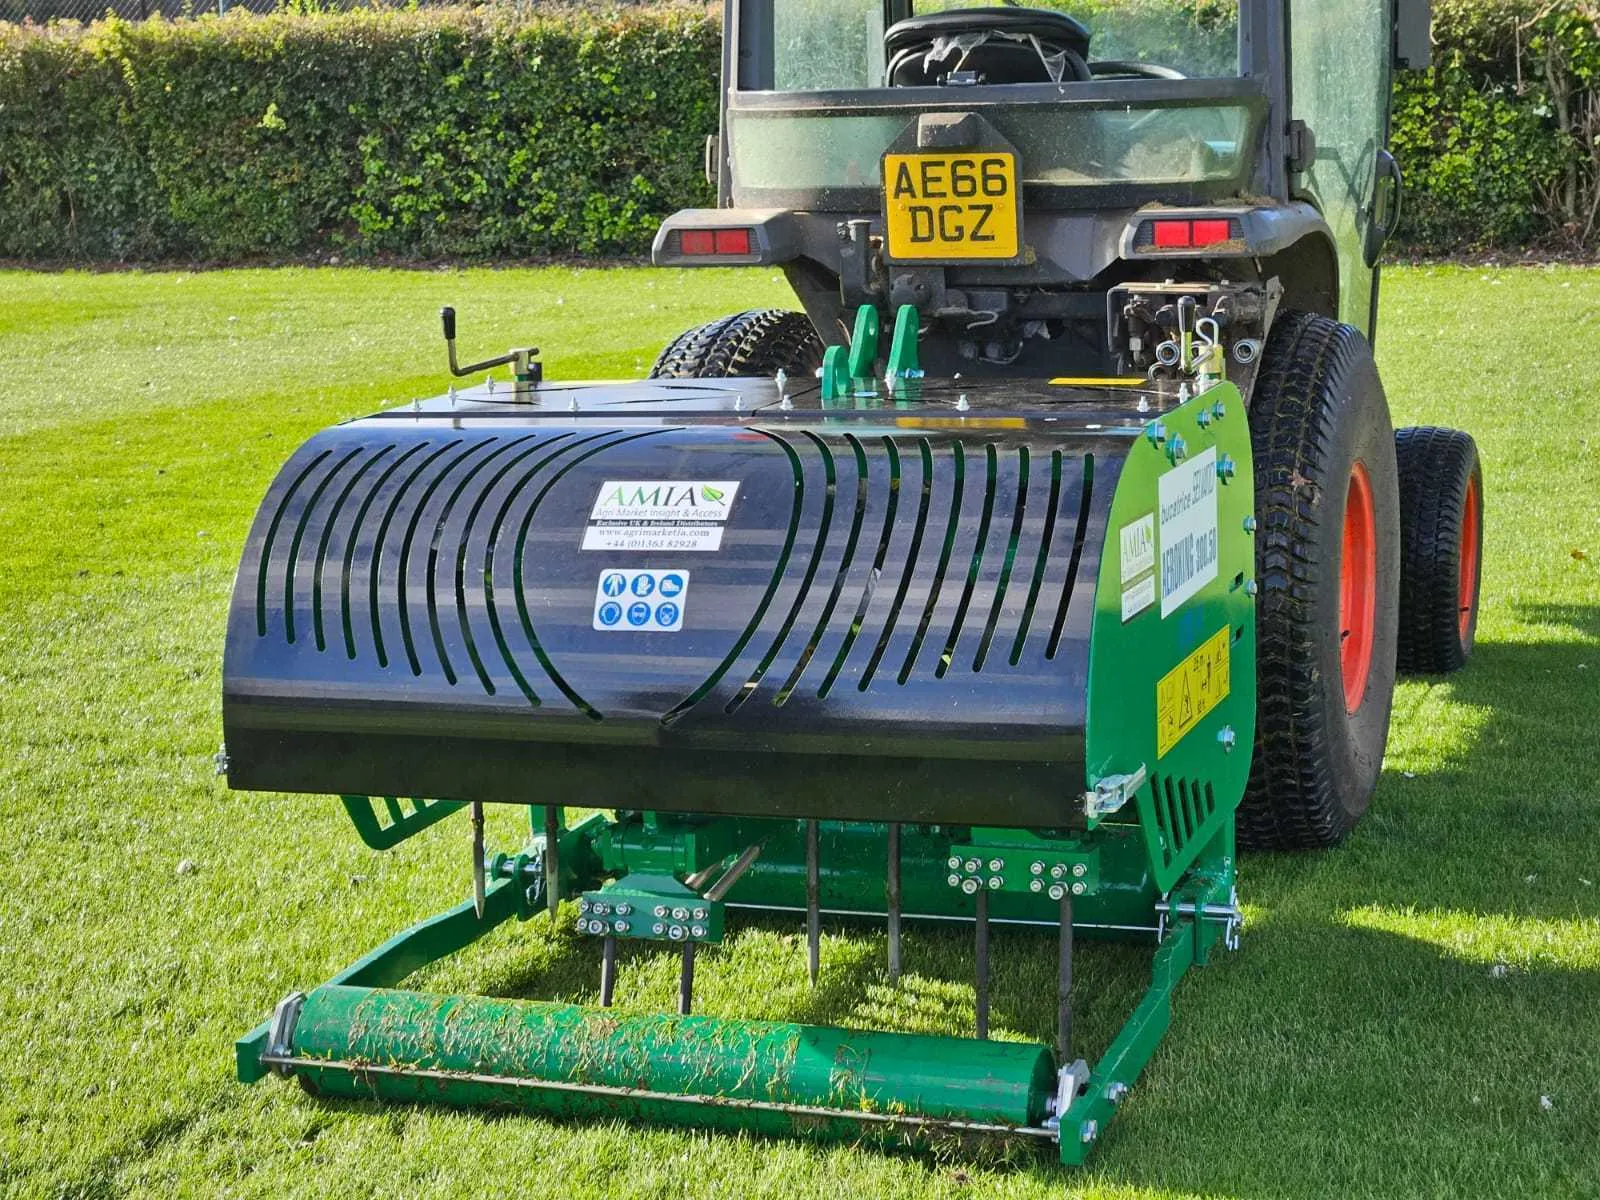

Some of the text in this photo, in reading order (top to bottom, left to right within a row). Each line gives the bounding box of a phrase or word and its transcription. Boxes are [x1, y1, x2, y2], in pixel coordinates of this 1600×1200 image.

[894, 158, 1008, 199] AE66
[908, 203, 996, 243] DGZ
[601, 485, 697, 507] AMIA
[617, 509, 648, 518] Market
[682, 509, 690, 518] &
[692, 509, 722, 518] Access
